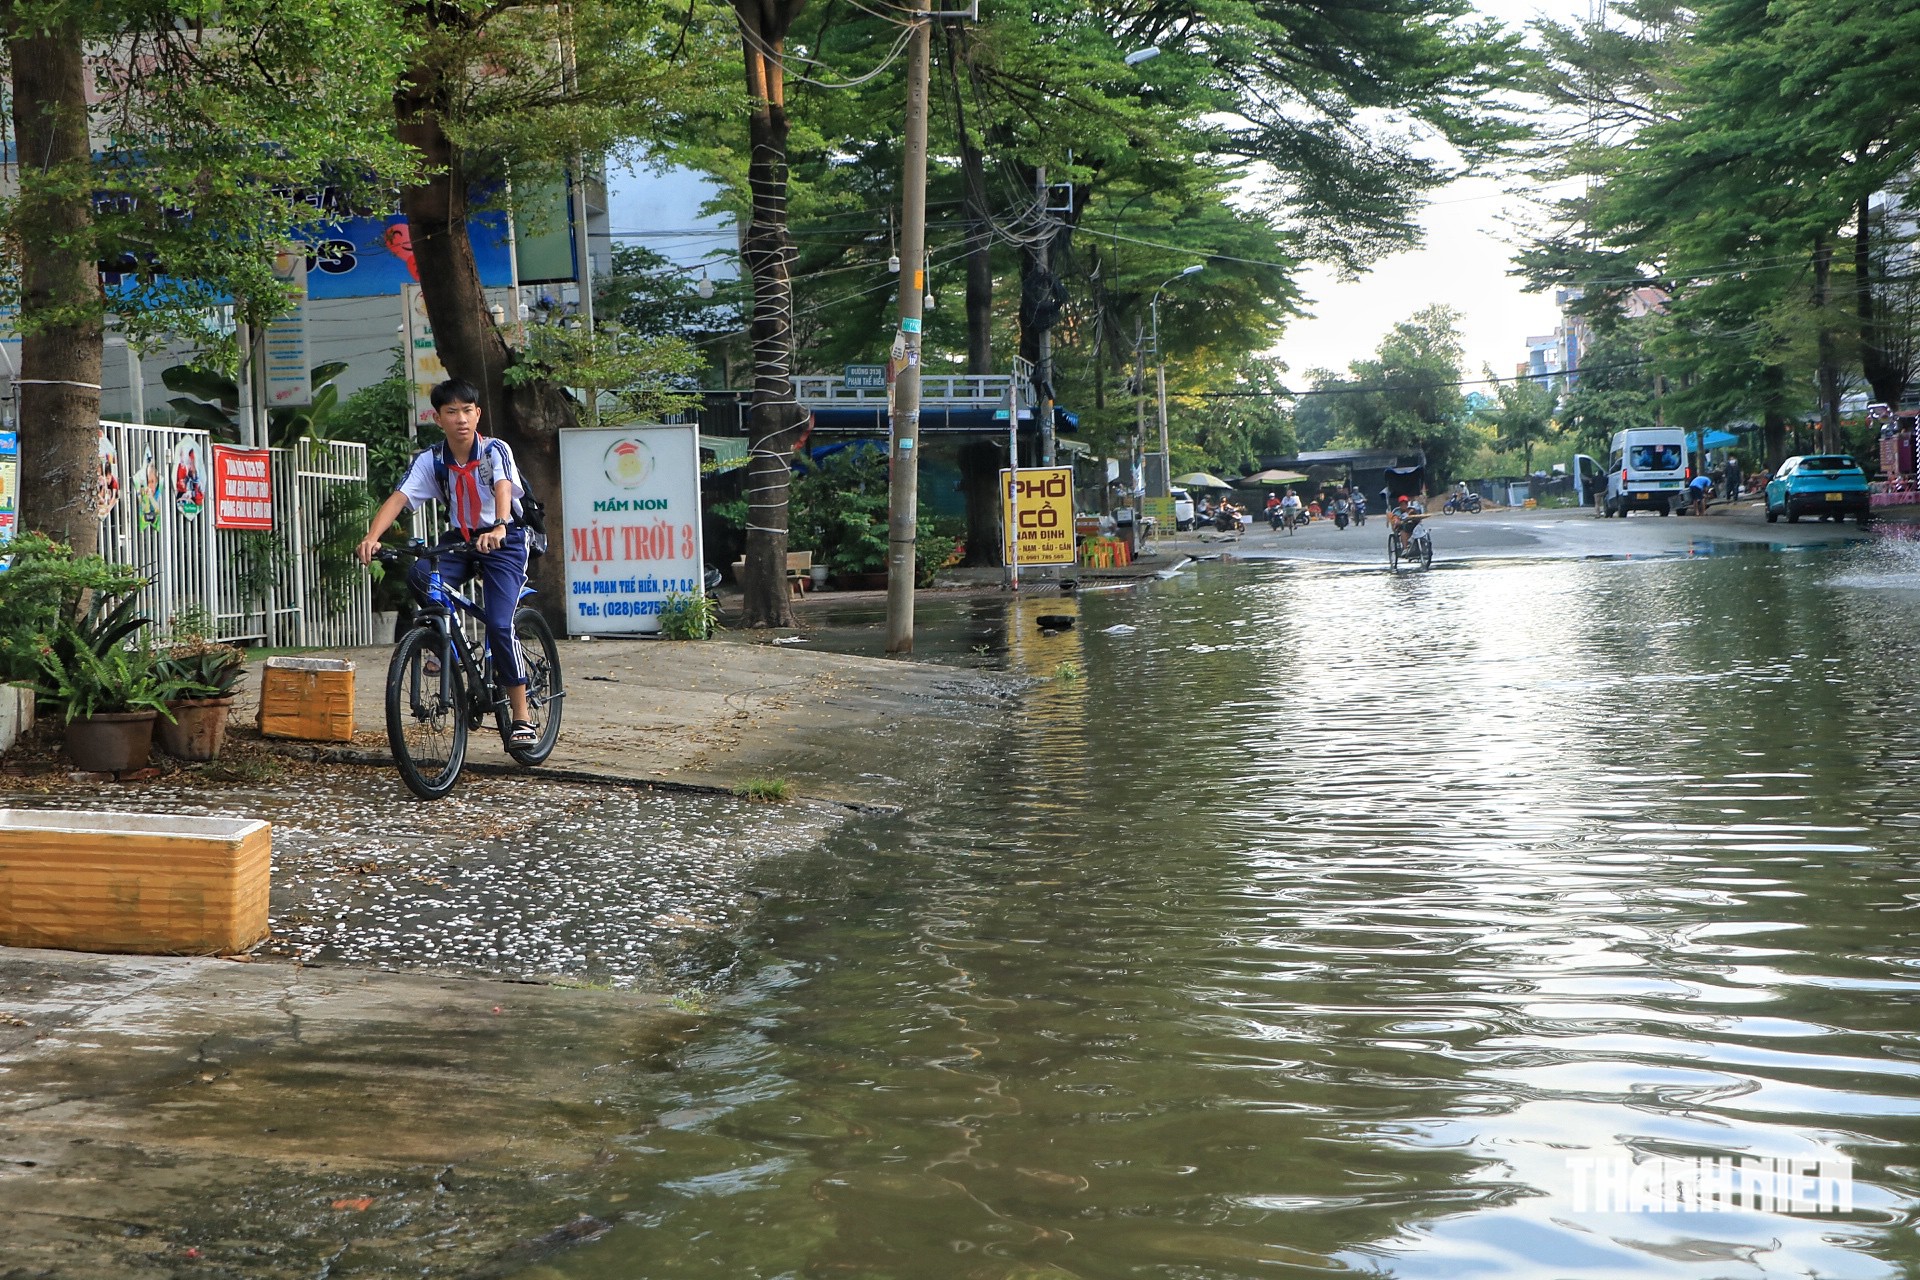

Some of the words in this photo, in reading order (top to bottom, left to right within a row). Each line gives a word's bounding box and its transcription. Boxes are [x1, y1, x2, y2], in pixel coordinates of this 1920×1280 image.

[847, 377, 862, 387] PHẠM
[863, 375, 872, 386] THẾ
[1008, 473, 1067, 499] PHỞ
[633, 499, 668, 511] NON
[1019, 500, 1058, 528] CỒ
[1040, 530, 1065, 541] ĐỊNH
[571, 519, 615, 575] MẶT
[621, 516, 675, 561] TRỜI
[682, 524, 695, 560] 3
[573, 581, 591, 594] 3144
[594, 580, 617, 597] PHẠM
[619, 576, 636, 593] THẾ
[578, 602, 600, 616] Tel:
